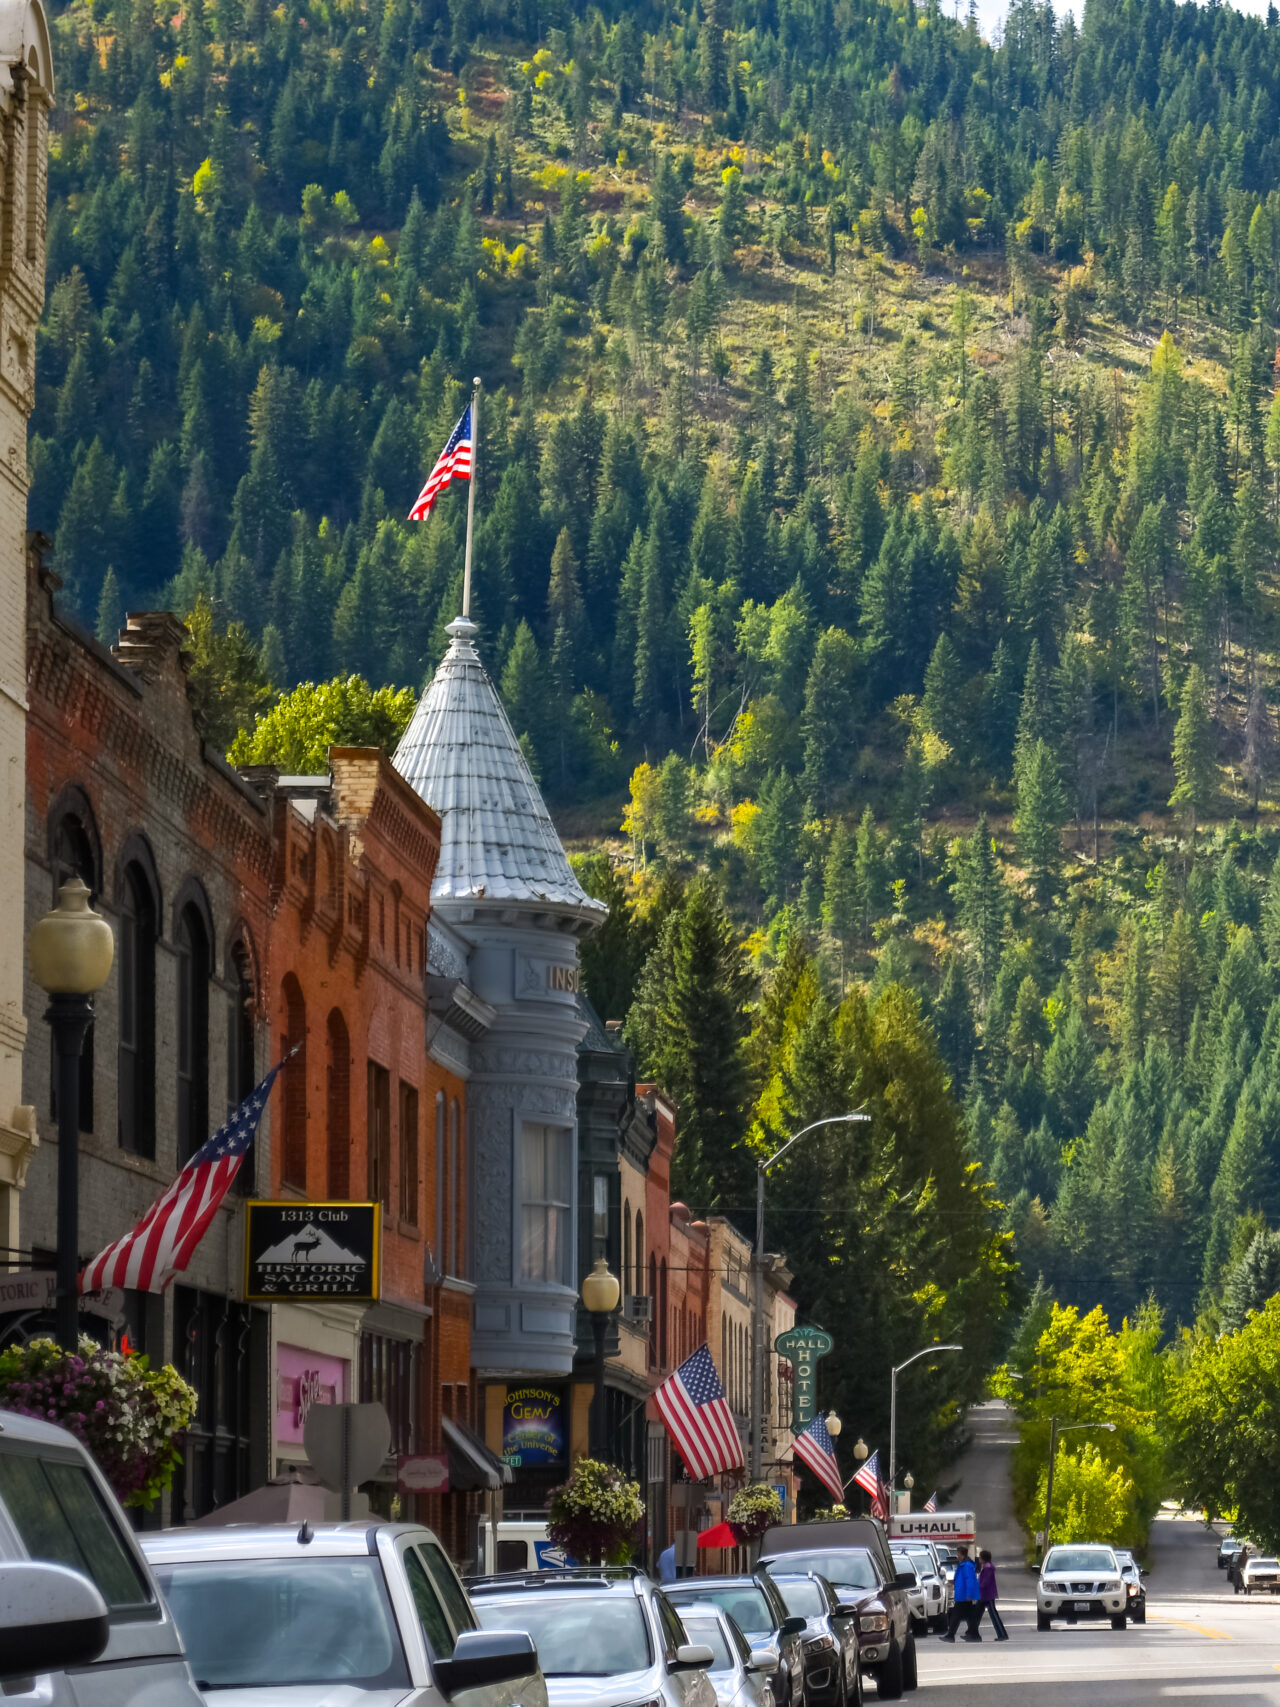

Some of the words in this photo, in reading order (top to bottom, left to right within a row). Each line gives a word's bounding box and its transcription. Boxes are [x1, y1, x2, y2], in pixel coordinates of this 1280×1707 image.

[281, 1210, 314, 1221] 1313
[318, 1210, 349, 1222] Club
[257, 1264, 366, 1273] HISTORIC
[264, 1274, 356, 1283] SALOON
[261, 1283, 278, 1292] &
[288, 1283, 360, 1292] GRILL
[786, 1340, 825, 1348] HALL
[798, 1350, 811, 1422] HOTEL
[504, 1388, 561, 1407] JOHNSON'S
[760, 1417, 769, 1454] REAL
[504, 1443, 519, 1456] the
[520, 1440, 558, 1456] Universe
[900, 1522, 961, 1534] U-HAUL
